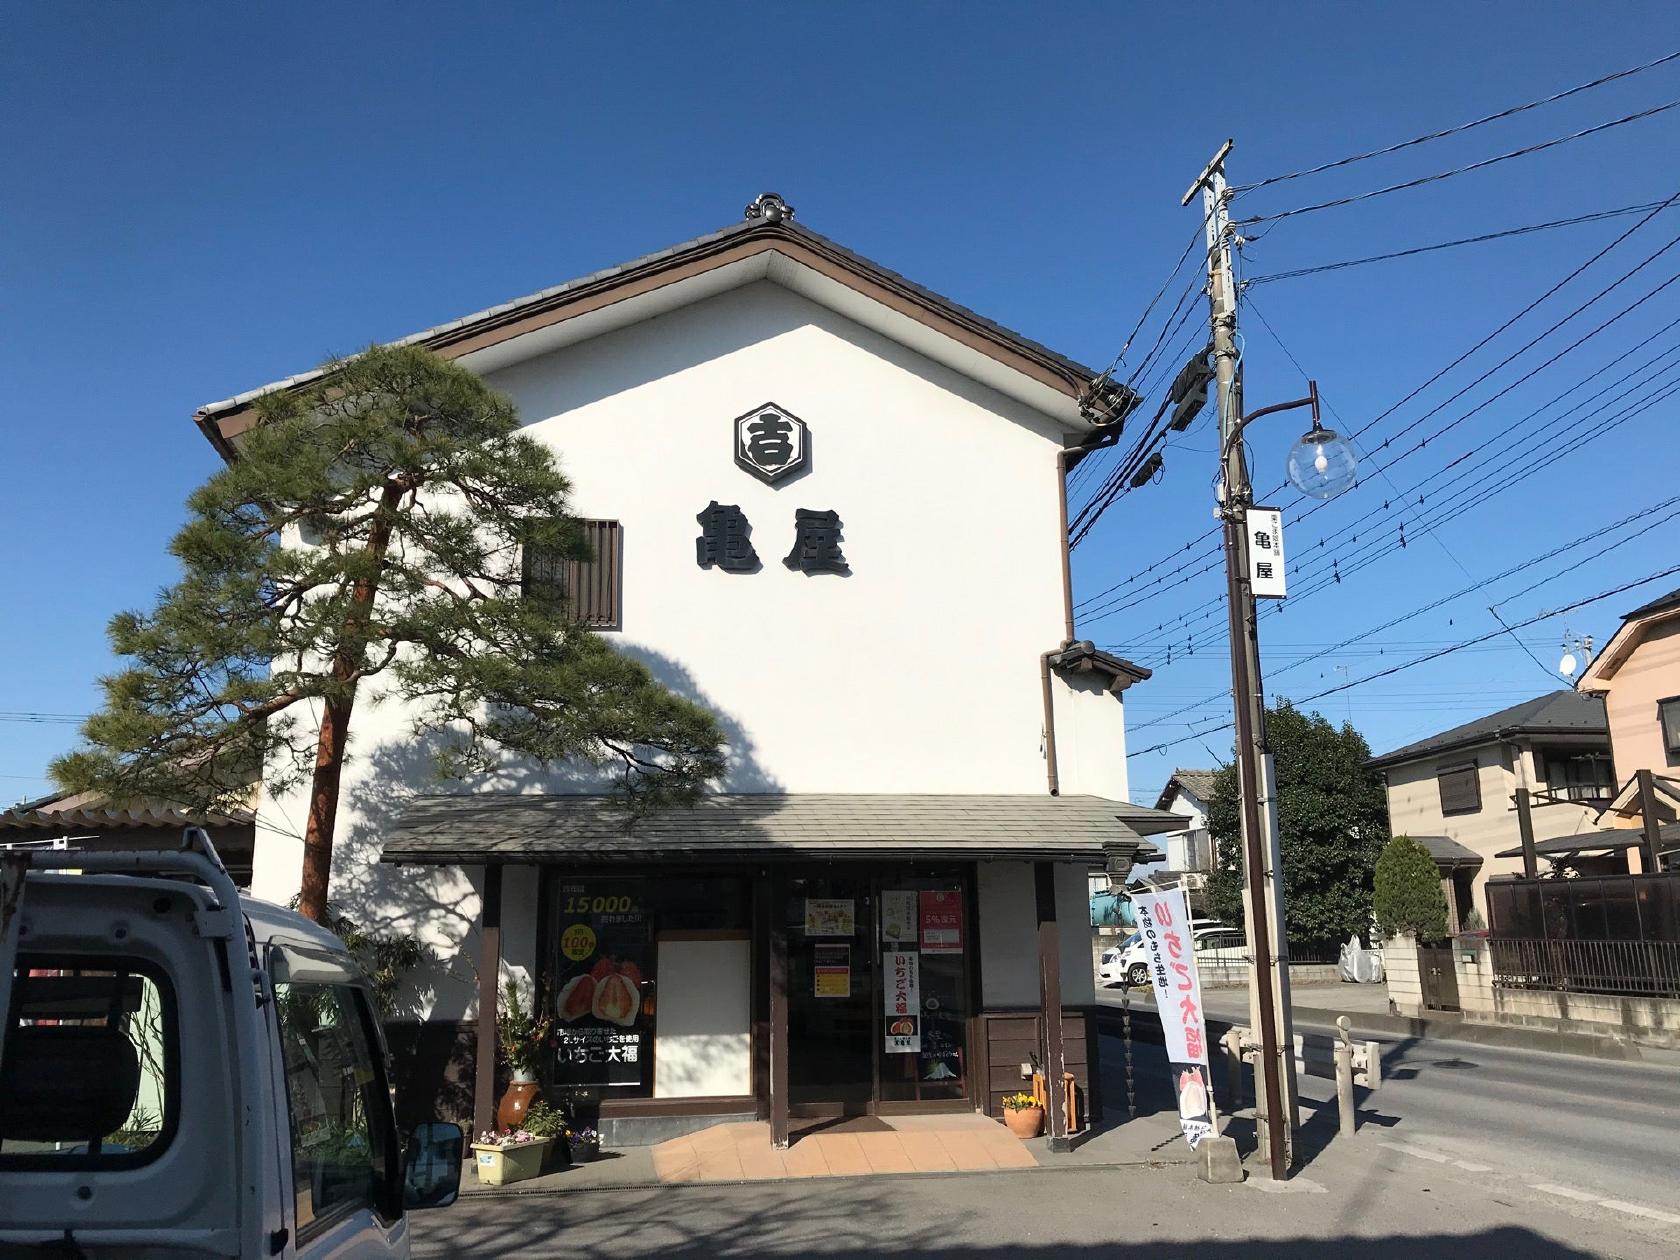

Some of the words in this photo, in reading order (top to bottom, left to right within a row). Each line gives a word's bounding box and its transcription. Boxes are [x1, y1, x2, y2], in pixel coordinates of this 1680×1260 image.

[696, 500, 851, 577] 亀屋
[1253, 530, 1274, 579] 亀屋
[895, 955, 907, 1014] いちご大福
[557, 1045, 639, 1063] いちご大福
